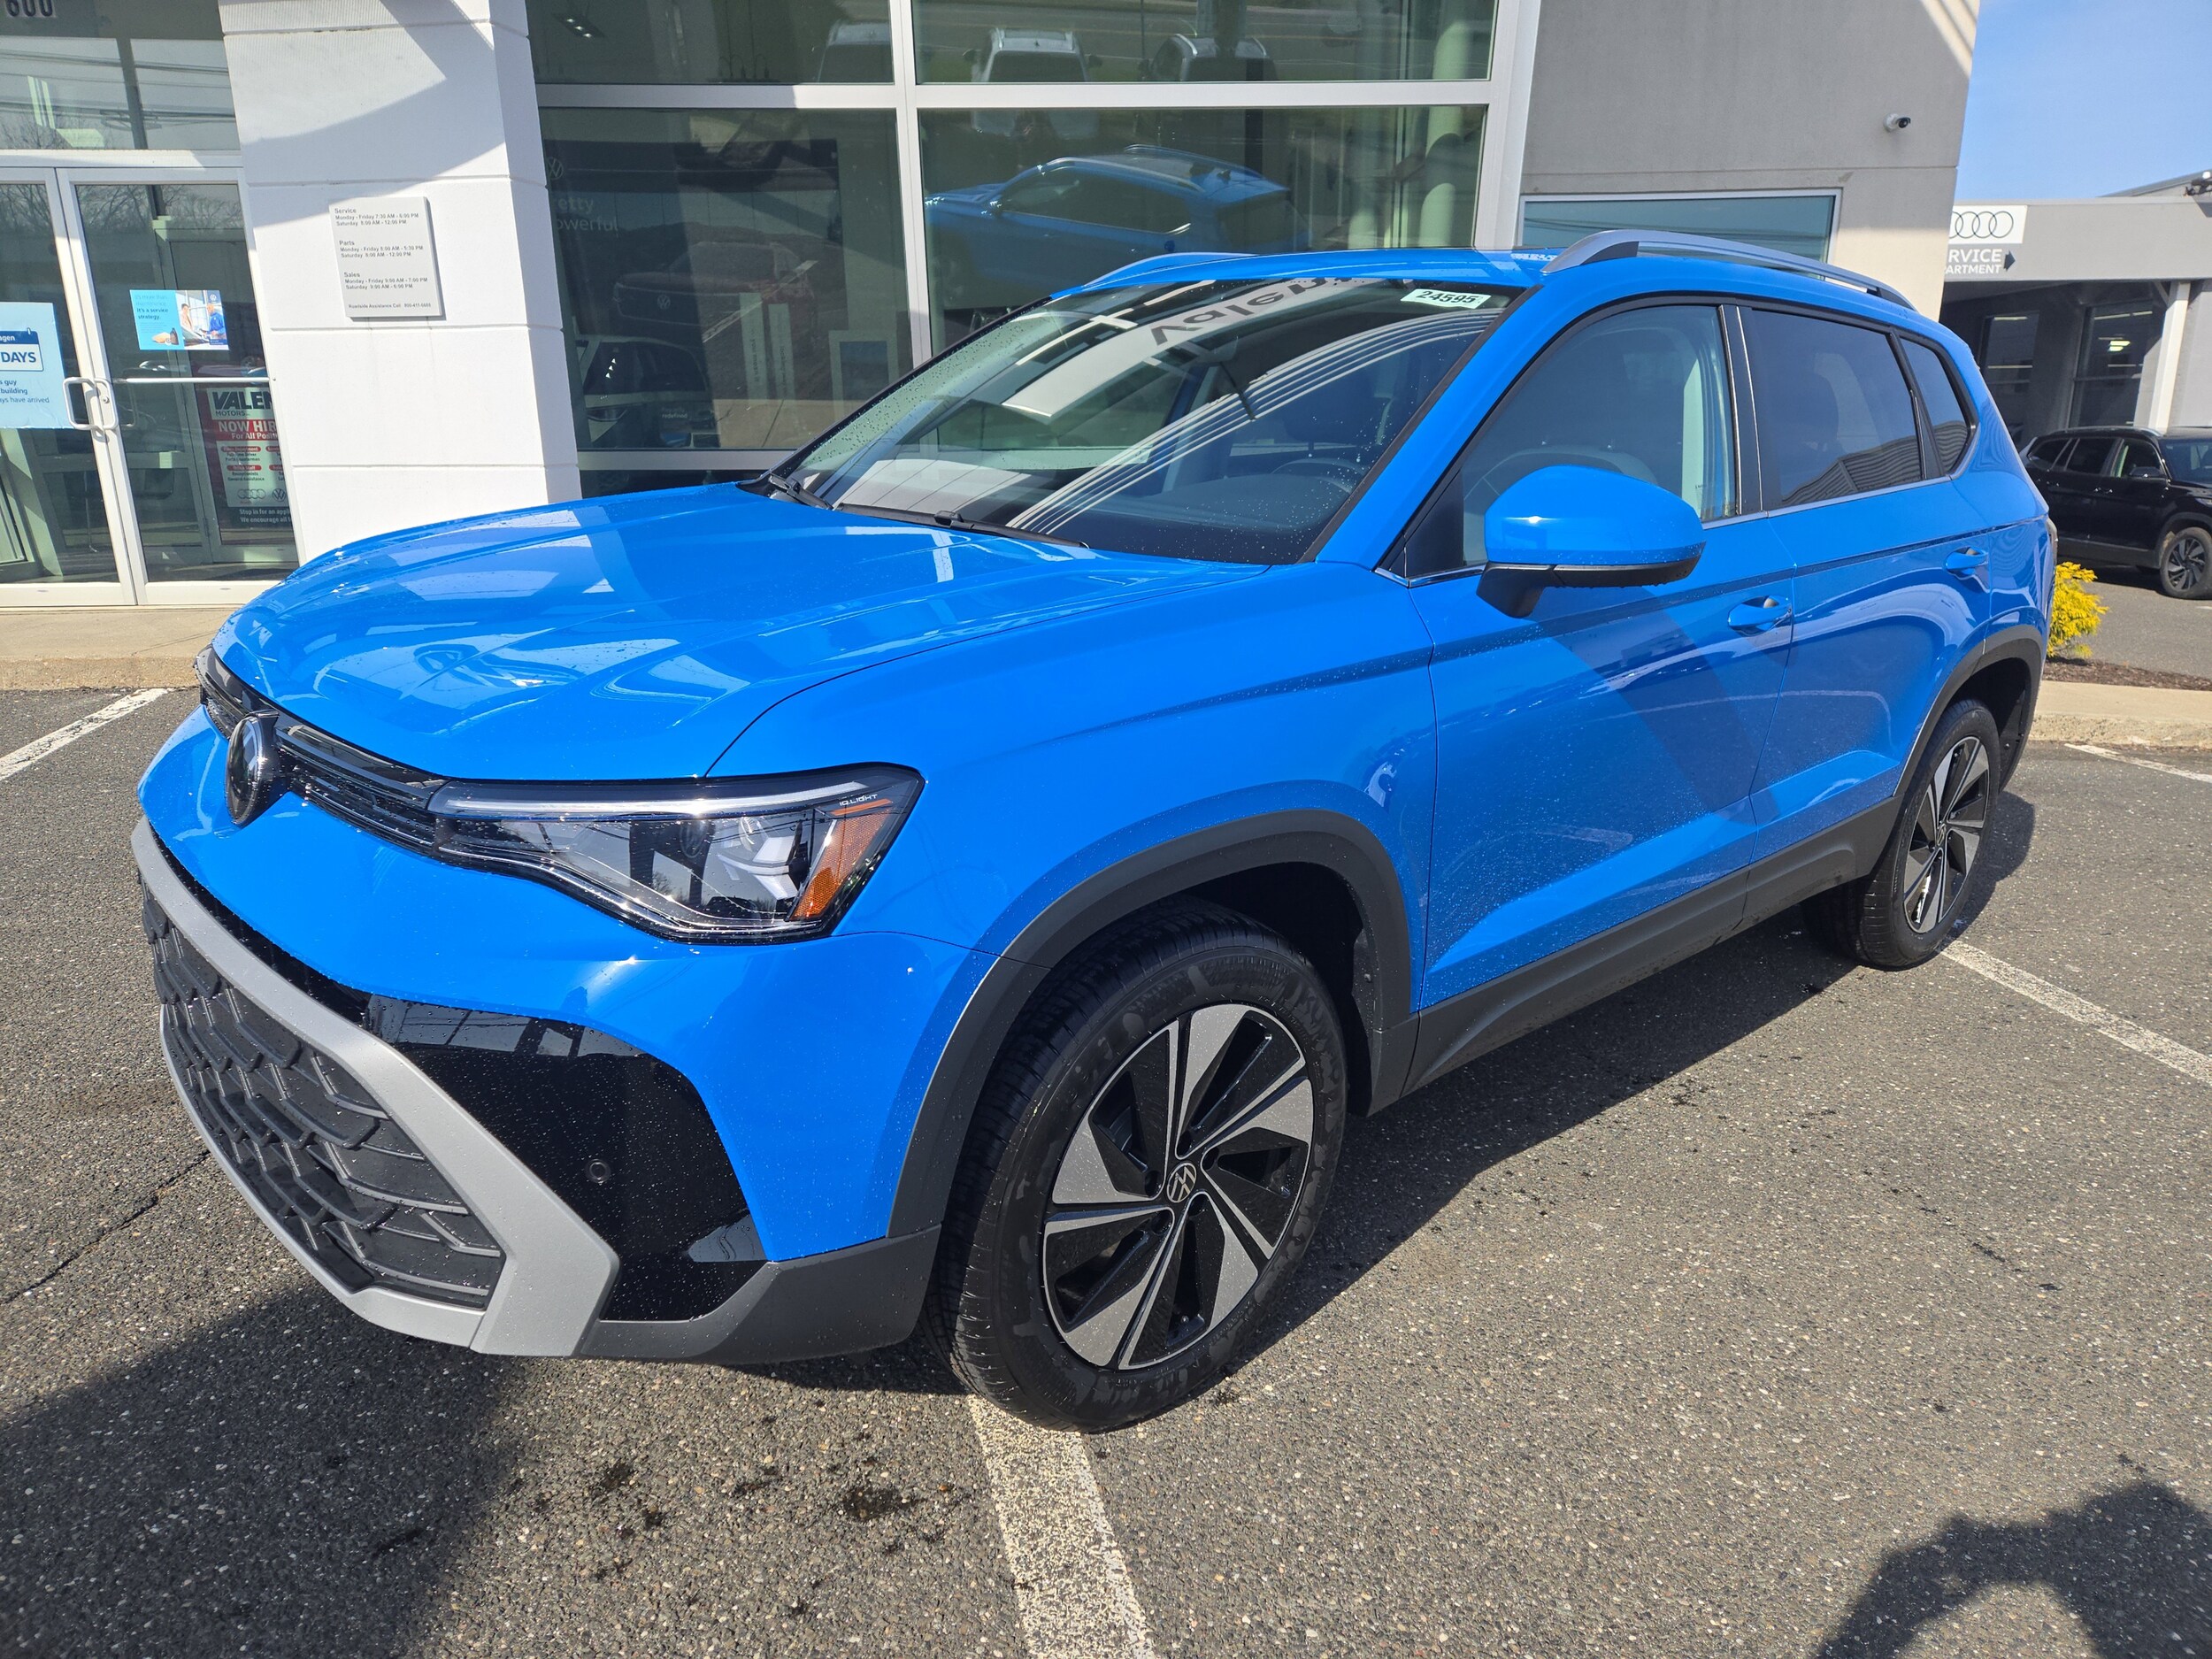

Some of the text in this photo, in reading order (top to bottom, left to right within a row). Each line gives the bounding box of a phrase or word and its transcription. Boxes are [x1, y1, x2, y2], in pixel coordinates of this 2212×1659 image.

[1417, 290, 1479, 303] 24595
[2, 351, 36, 363] DAYS
[218, 420, 250, 433] NOW
